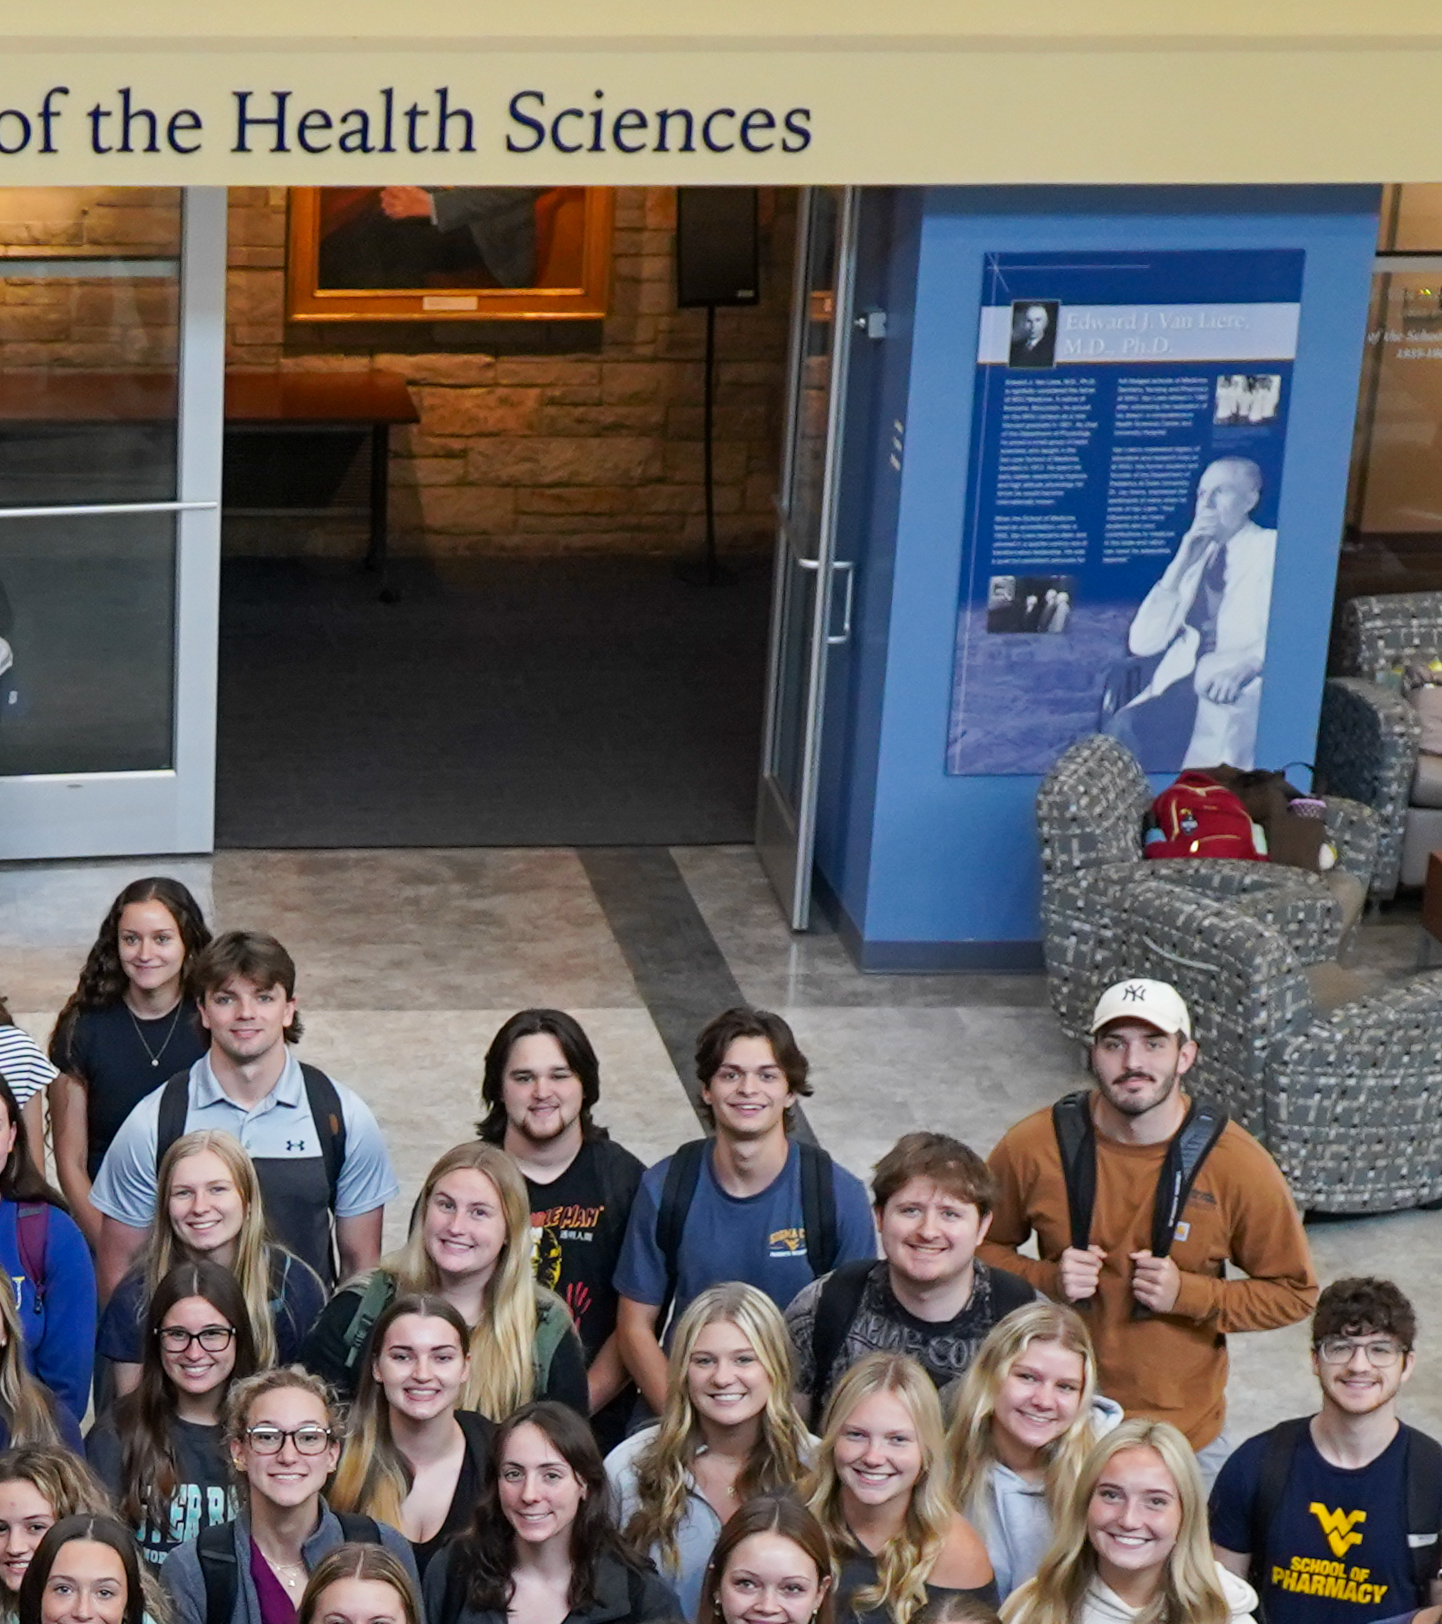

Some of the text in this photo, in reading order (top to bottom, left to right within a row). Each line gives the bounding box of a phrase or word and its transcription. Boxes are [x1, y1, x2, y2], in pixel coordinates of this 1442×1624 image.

[87, 90, 204, 156] the
[229, 86, 477, 156] Health
[504, 88, 812, 156] Sciences
[1271, 1565, 1389, 1605] PHARMACY
[1290, 1555, 1371, 1583] SCHOOL OF
